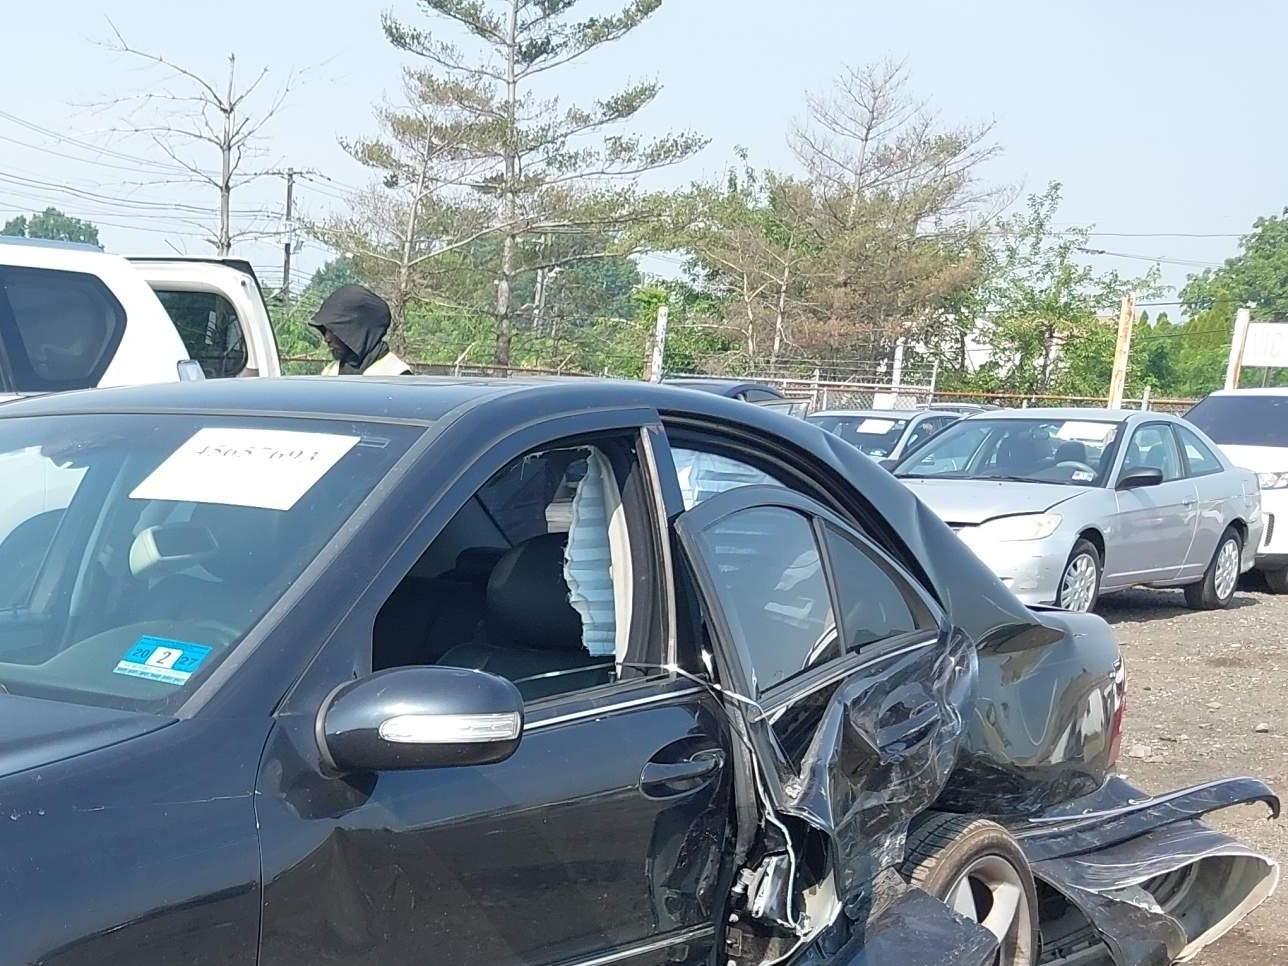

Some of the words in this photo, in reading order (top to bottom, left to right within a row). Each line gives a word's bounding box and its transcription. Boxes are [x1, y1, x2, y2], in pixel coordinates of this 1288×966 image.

[132, 648, 151, 658] 20
[156, 650, 172, 664] 2
[178, 656, 199, 667] 27
